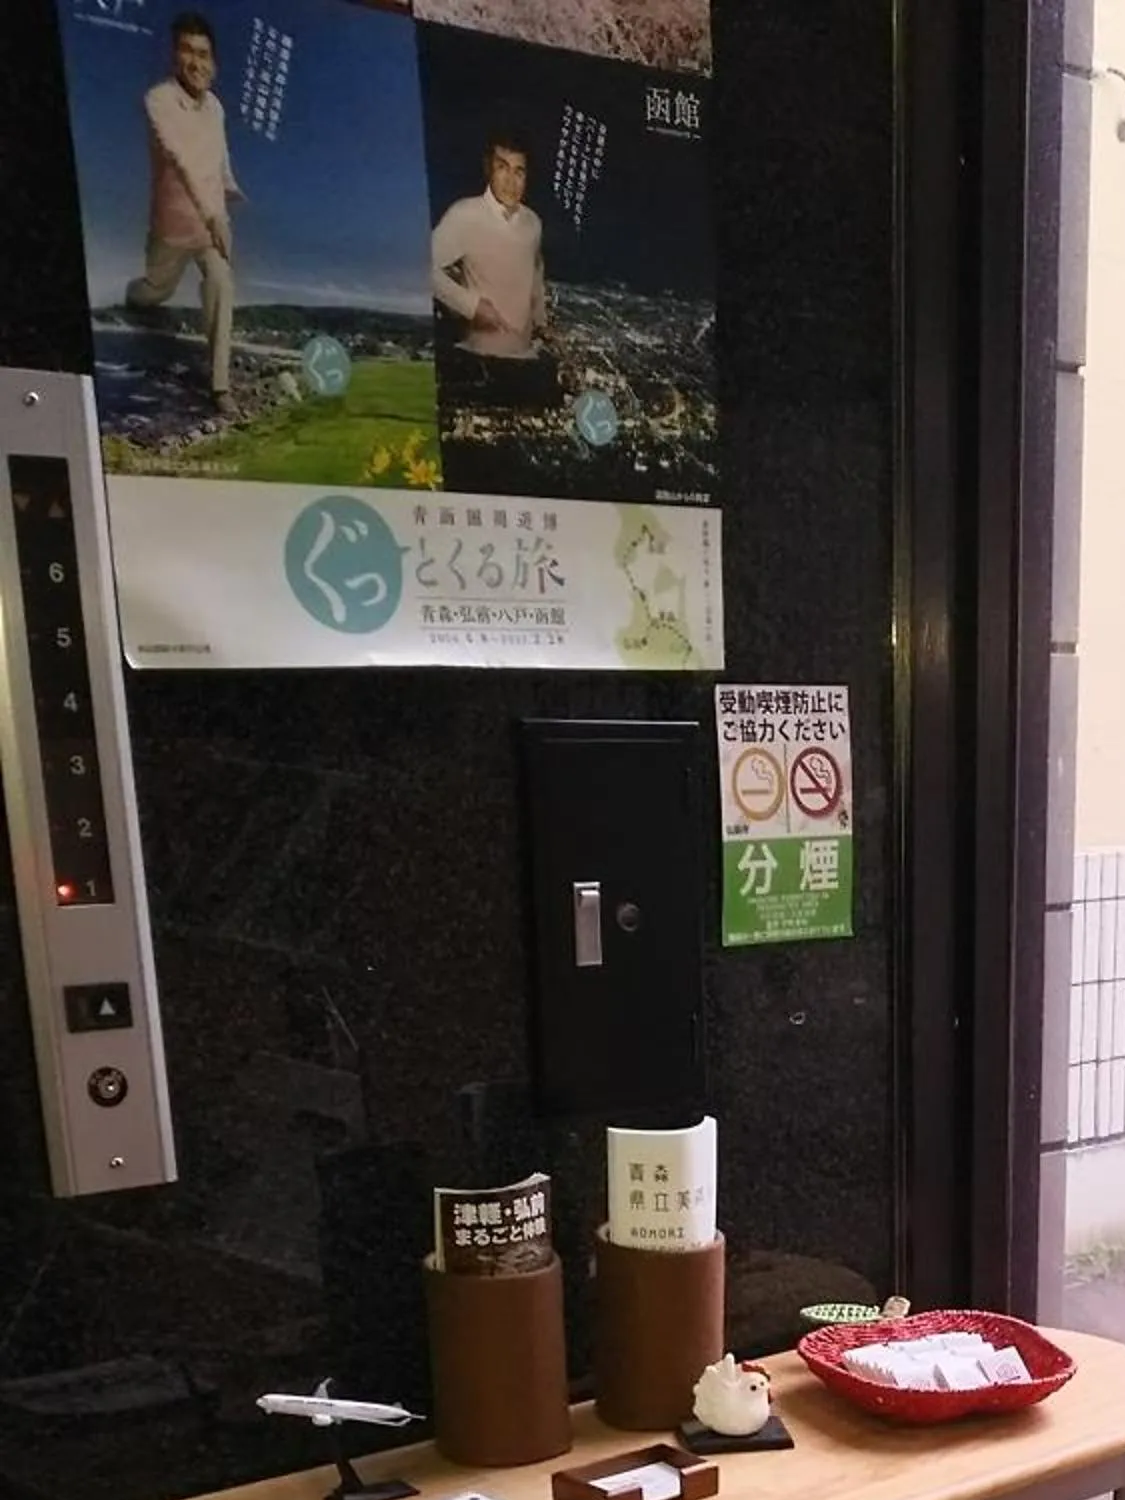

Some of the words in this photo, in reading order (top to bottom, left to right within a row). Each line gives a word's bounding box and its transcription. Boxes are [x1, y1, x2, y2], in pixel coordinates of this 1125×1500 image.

[645, 86, 701, 129] 函館
[49, 562, 65, 583] 6
[303, 510, 388, 625] ぐっ
[415, 535, 566, 595] とくる旅
[56, 627, 72, 648] 5
[63, 692, 78, 713] 4
[719, 689, 845, 716] 受動喫煙防止に
[722, 719, 847, 744] ご協力ください
[69, 755, 86, 775] 3
[77, 818, 93, 838] 2
[737, 839, 840, 898] 分煙
[86, 880, 97, 896] 1
[629, 1163, 670, 1182] 青森
